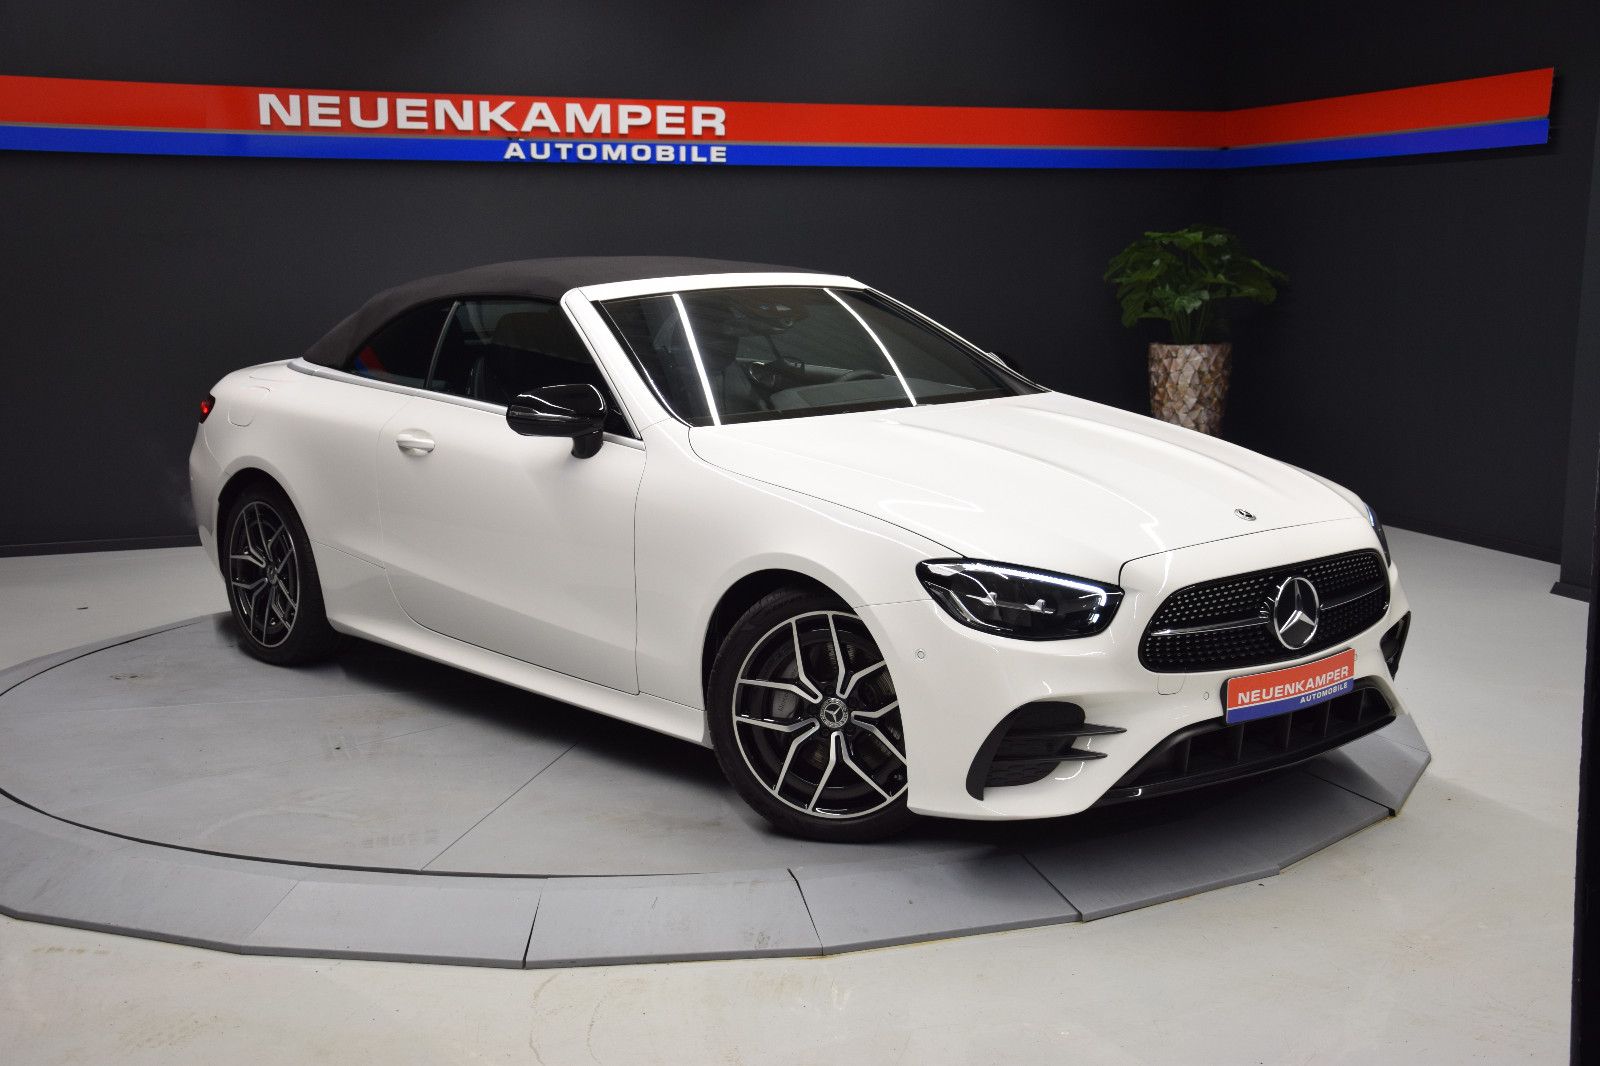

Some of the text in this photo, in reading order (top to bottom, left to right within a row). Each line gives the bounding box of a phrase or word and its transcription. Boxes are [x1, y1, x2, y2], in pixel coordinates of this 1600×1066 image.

[258, 93, 727, 137] NEUENKAMPER
[503, 142, 728, 163] AUTOMOBILE
[1237, 665, 1349, 705] NEUENKAMPER
[1299, 681, 1348, 704] AUTOMOBILE
